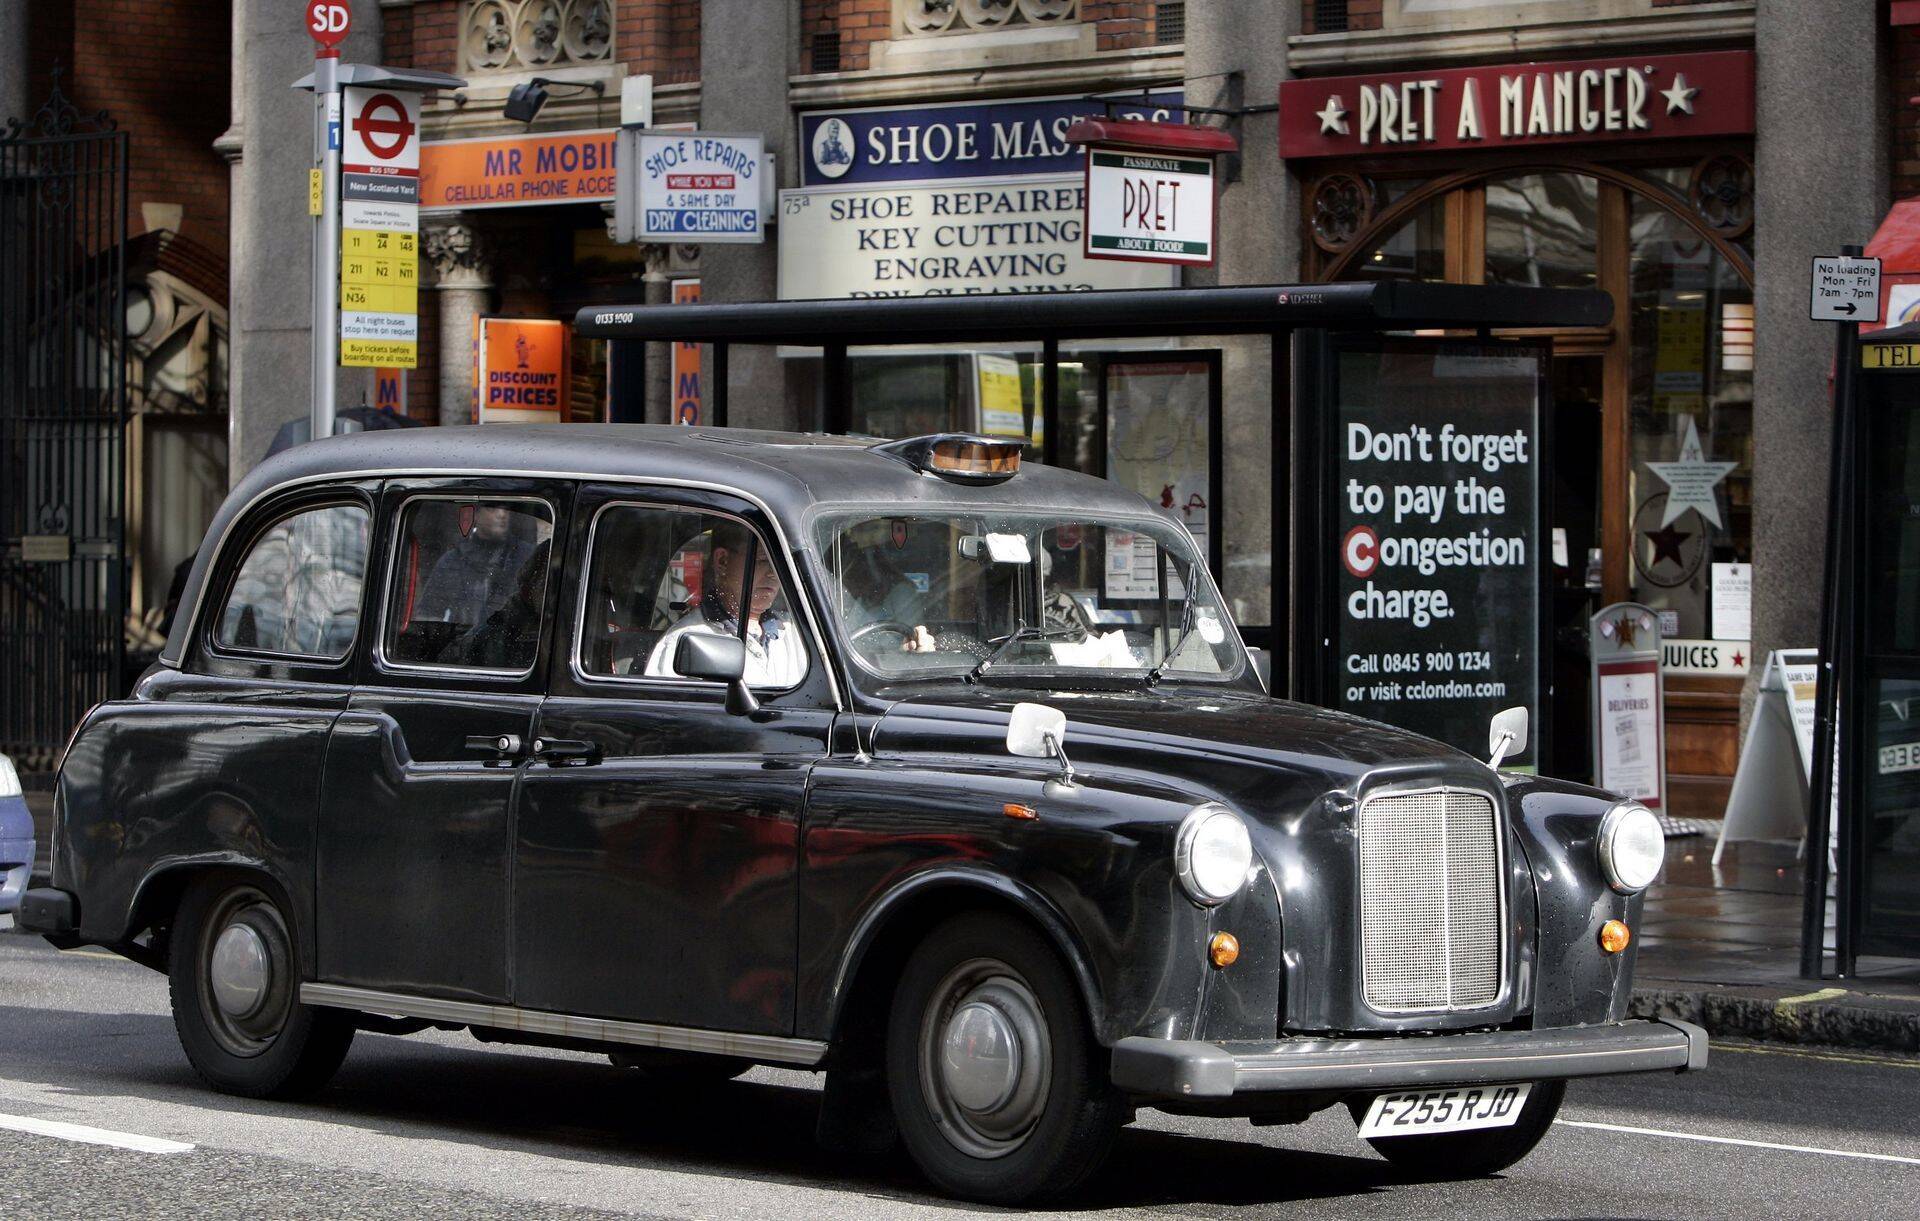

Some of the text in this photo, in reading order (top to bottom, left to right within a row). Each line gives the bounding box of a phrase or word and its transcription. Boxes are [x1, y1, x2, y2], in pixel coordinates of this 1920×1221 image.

[312, 4, 349, 32] SD
[1360, 67, 1649, 144] PRET A MANGER
[867, 122, 978, 166] SHOE
[485, 149, 521, 177] MR
[645, 139, 756, 180] SHOE REPAIRS
[1123, 157, 1181, 171] PASSIONATE
[350, 182, 415, 195] New Scotland Yard
[445, 181, 514, 202] CELLULAR
[522, 179, 568, 198] PHONE
[694, 176, 713, 188] YOU
[666, 193, 736, 207] & SAME DAY
[784, 195, 811, 215] 75a
[830, 195, 914, 221] SHOE
[1122, 177, 1181, 232] PRET
[649, 211, 755, 231] DRY CLEANING
[353, 238, 414, 252] 11 24 148
[857, 219, 1082, 252] KEY CUTTING
[1117, 238, 1185, 252] ABOUT FOOD!
[350, 264, 413, 279] 211 N2 N11
[874, 252, 1067, 281] ENGRAVING
[1818, 265, 1876, 276] No loading
[1823, 276, 1845, 286] Mon
[1857, 277, 1871, 286] Fri
[346, 293, 366, 304] N36
[1820, 287, 1840, 297] 7am
[1852, 288, 1874, 299] 7pm
[345, 326, 360, 335] stop
[363, 326, 378, 334] here
[391, 328, 415, 337] request
[355, 316, 405, 327] All night buses
[344, 352, 374, 363] boarding
[386, 354, 394, 362] all
[396, 355, 416, 363] routes
[350, 344, 410, 354] Buy tickets before
[490, 371, 557, 385] DISCOUNT
[490, 387, 557, 406] PRICES
[1348, 422, 1529, 472] Don't forget
[1347, 476, 1506, 523] to pay the
[1347, 528, 1525, 576] Congestion
[1348, 581, 1454, 628] charge.
[1347, 651, 1491, 674] Call 0845 900 1234
[1662, 645, 1719, 668] JUICES
[1347, 680, 1506, 702] or visit cclondon.com
[1608, 699, 1649, 712] DELIVERIES
[1374, 1087, 1519, 1127] F255 RJD
